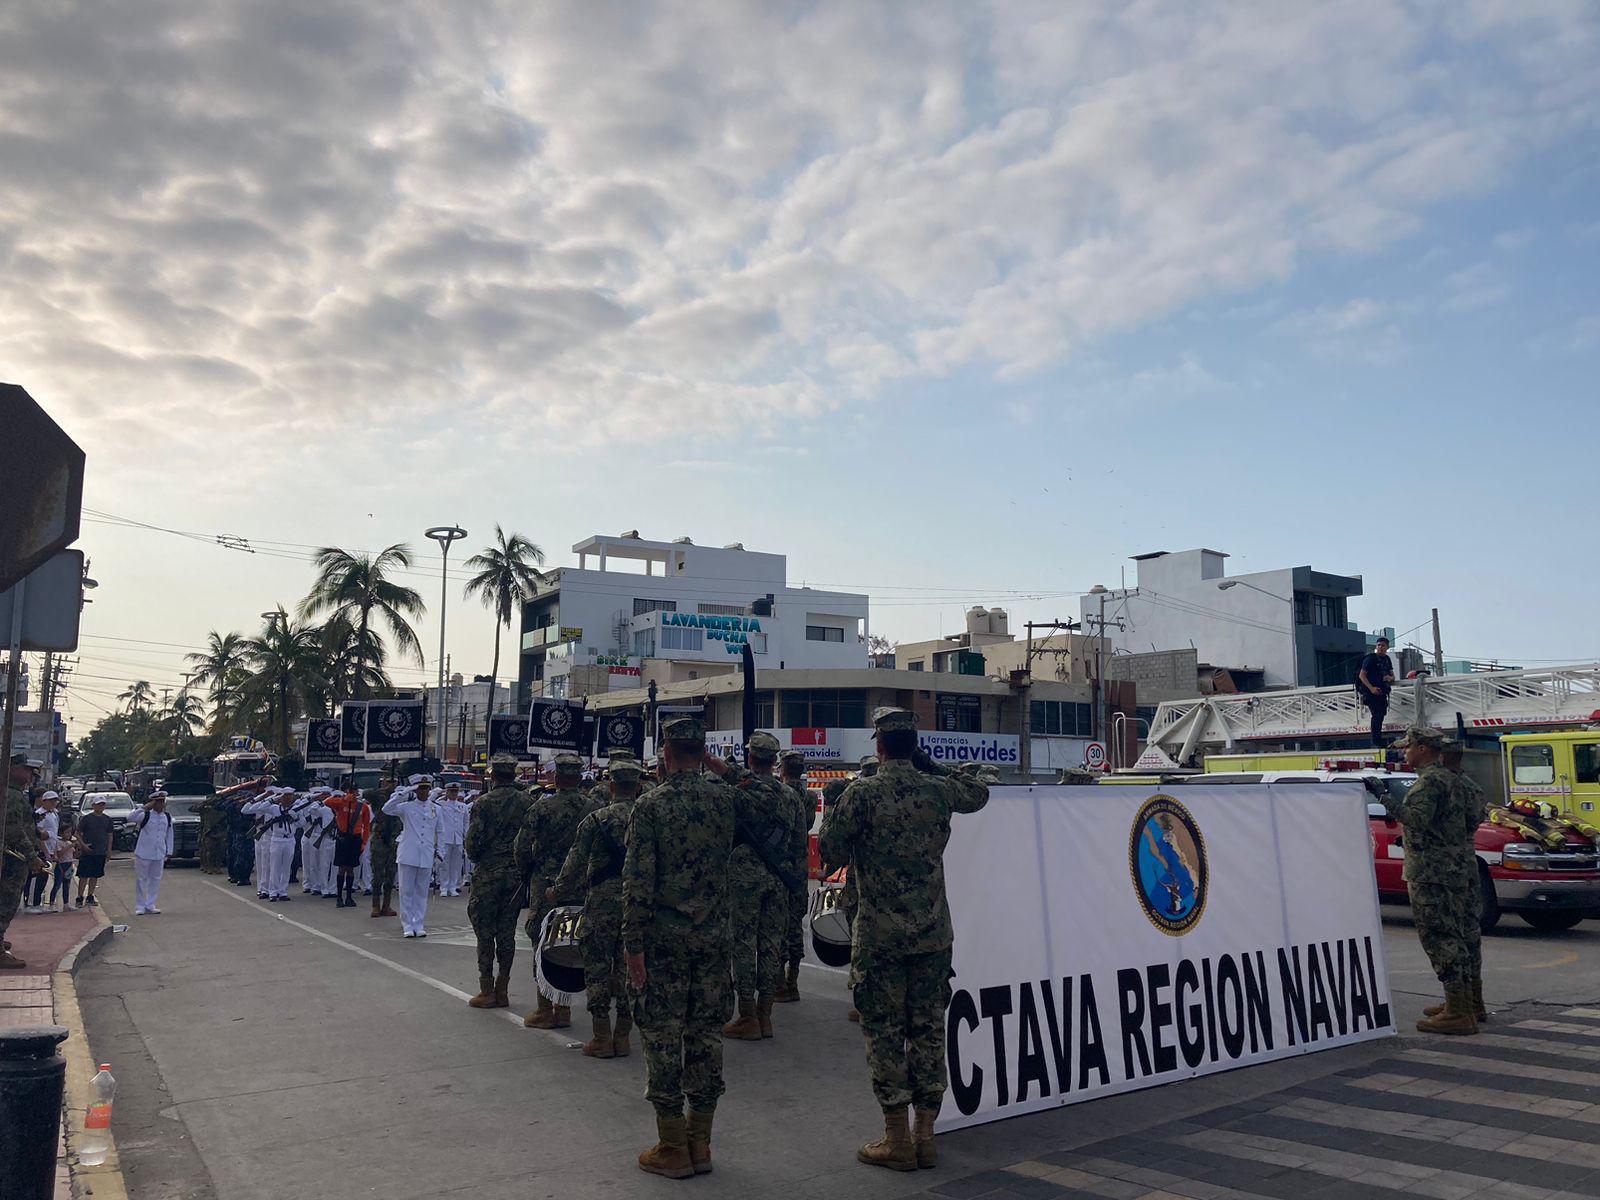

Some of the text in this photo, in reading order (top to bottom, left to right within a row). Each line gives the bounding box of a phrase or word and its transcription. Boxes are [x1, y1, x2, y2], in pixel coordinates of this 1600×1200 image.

[662, 612, 761, 632] LAVANDERIA
[706, 630, 748, 645] DUCHA
[596, 655, 629, 666] BIKE
[927, 735, 968, 745] farmacias
[804, 747, 841, 758] navides
[920, 736, 1017, 762] benavides
[1090, 747, 1101, 759] 30
[946, 936, 1391, 1117] CTAVA REGION NAVAL
